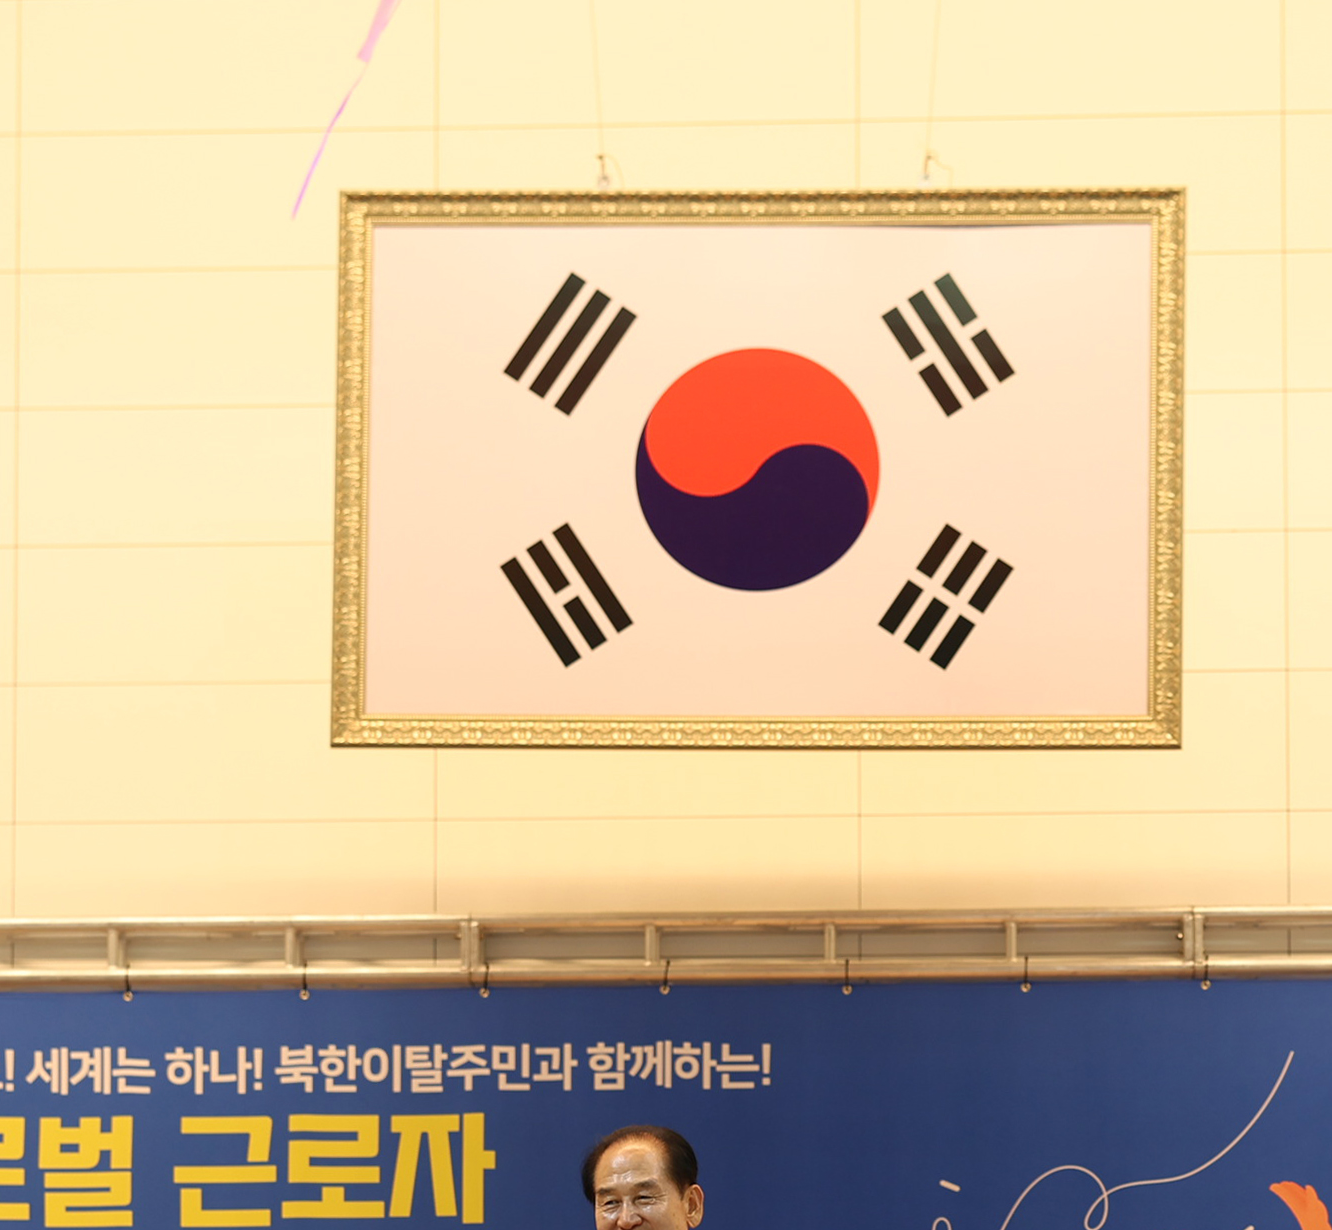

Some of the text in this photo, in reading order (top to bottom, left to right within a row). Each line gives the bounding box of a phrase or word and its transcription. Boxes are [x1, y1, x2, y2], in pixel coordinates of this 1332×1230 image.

[25, 1045, 157, 1096] 세계는
[164, 1045, 264, 1096] 하나!
[274, 1042, 579, 1094] 북한이탈주민과
[586, 1039, 772, 1092] 함께하는!
[172, 1111, 497, 1229] 근로자
